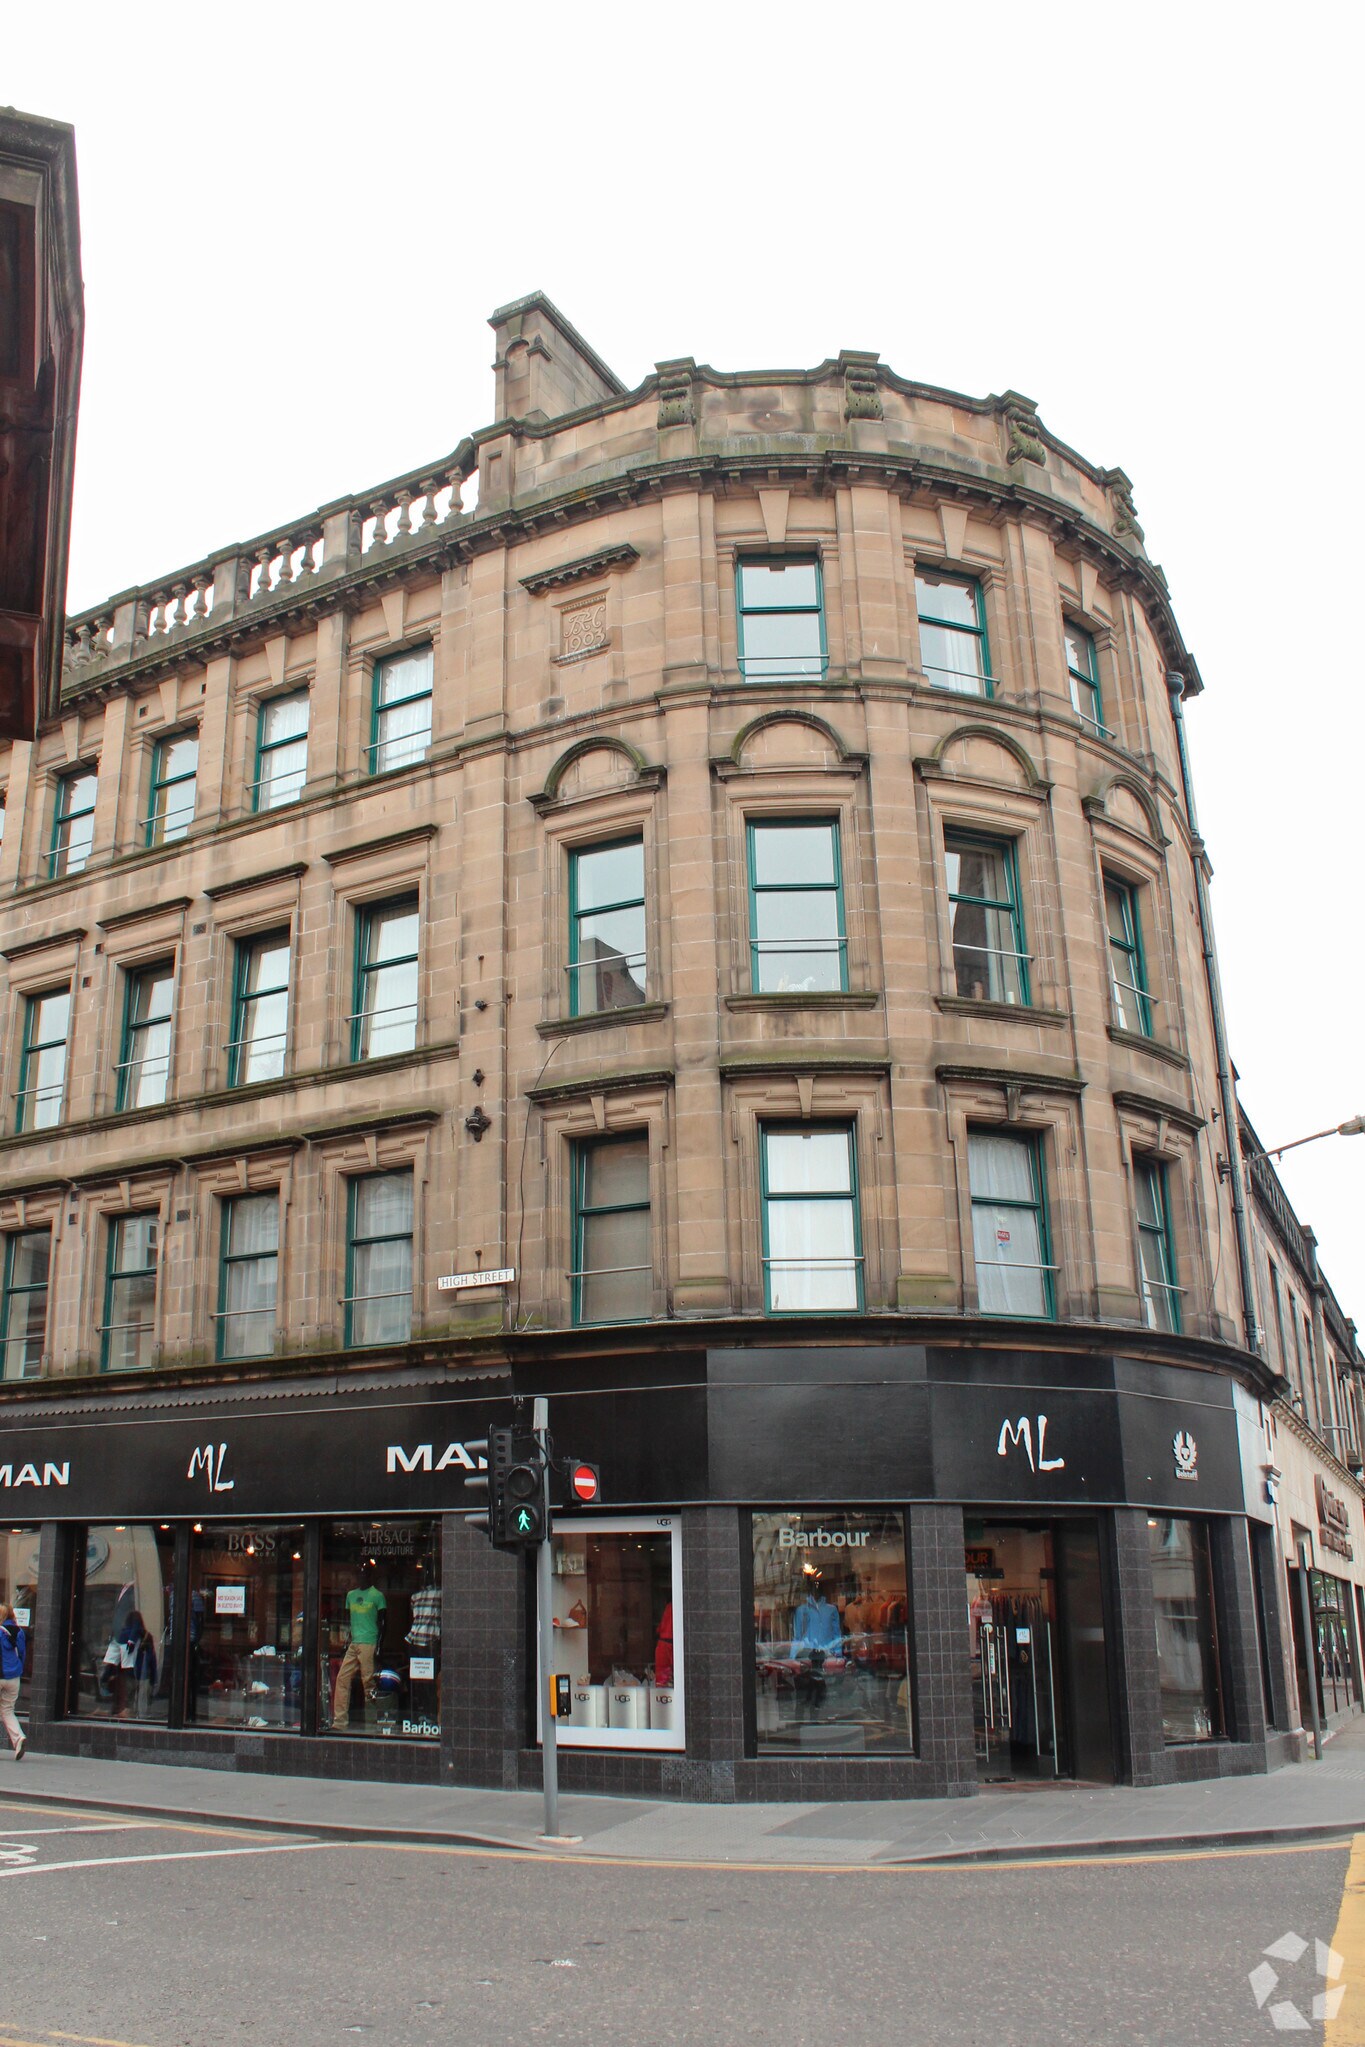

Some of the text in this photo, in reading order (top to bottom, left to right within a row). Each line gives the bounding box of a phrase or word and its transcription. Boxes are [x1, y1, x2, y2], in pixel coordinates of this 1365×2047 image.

[441, 1271, 510, 1288] HIGH STREET
[386, 1442, 488, 1473] MA
[228, 1532, 276, 1551] BOSS
[361, 1529, 415, 1544] VERSACE
[779, 1527, 870, 1547] Barbour
[382, 1546, 415, 1556] COUTURE
[402, 1720, 442, 1735] Barbo
